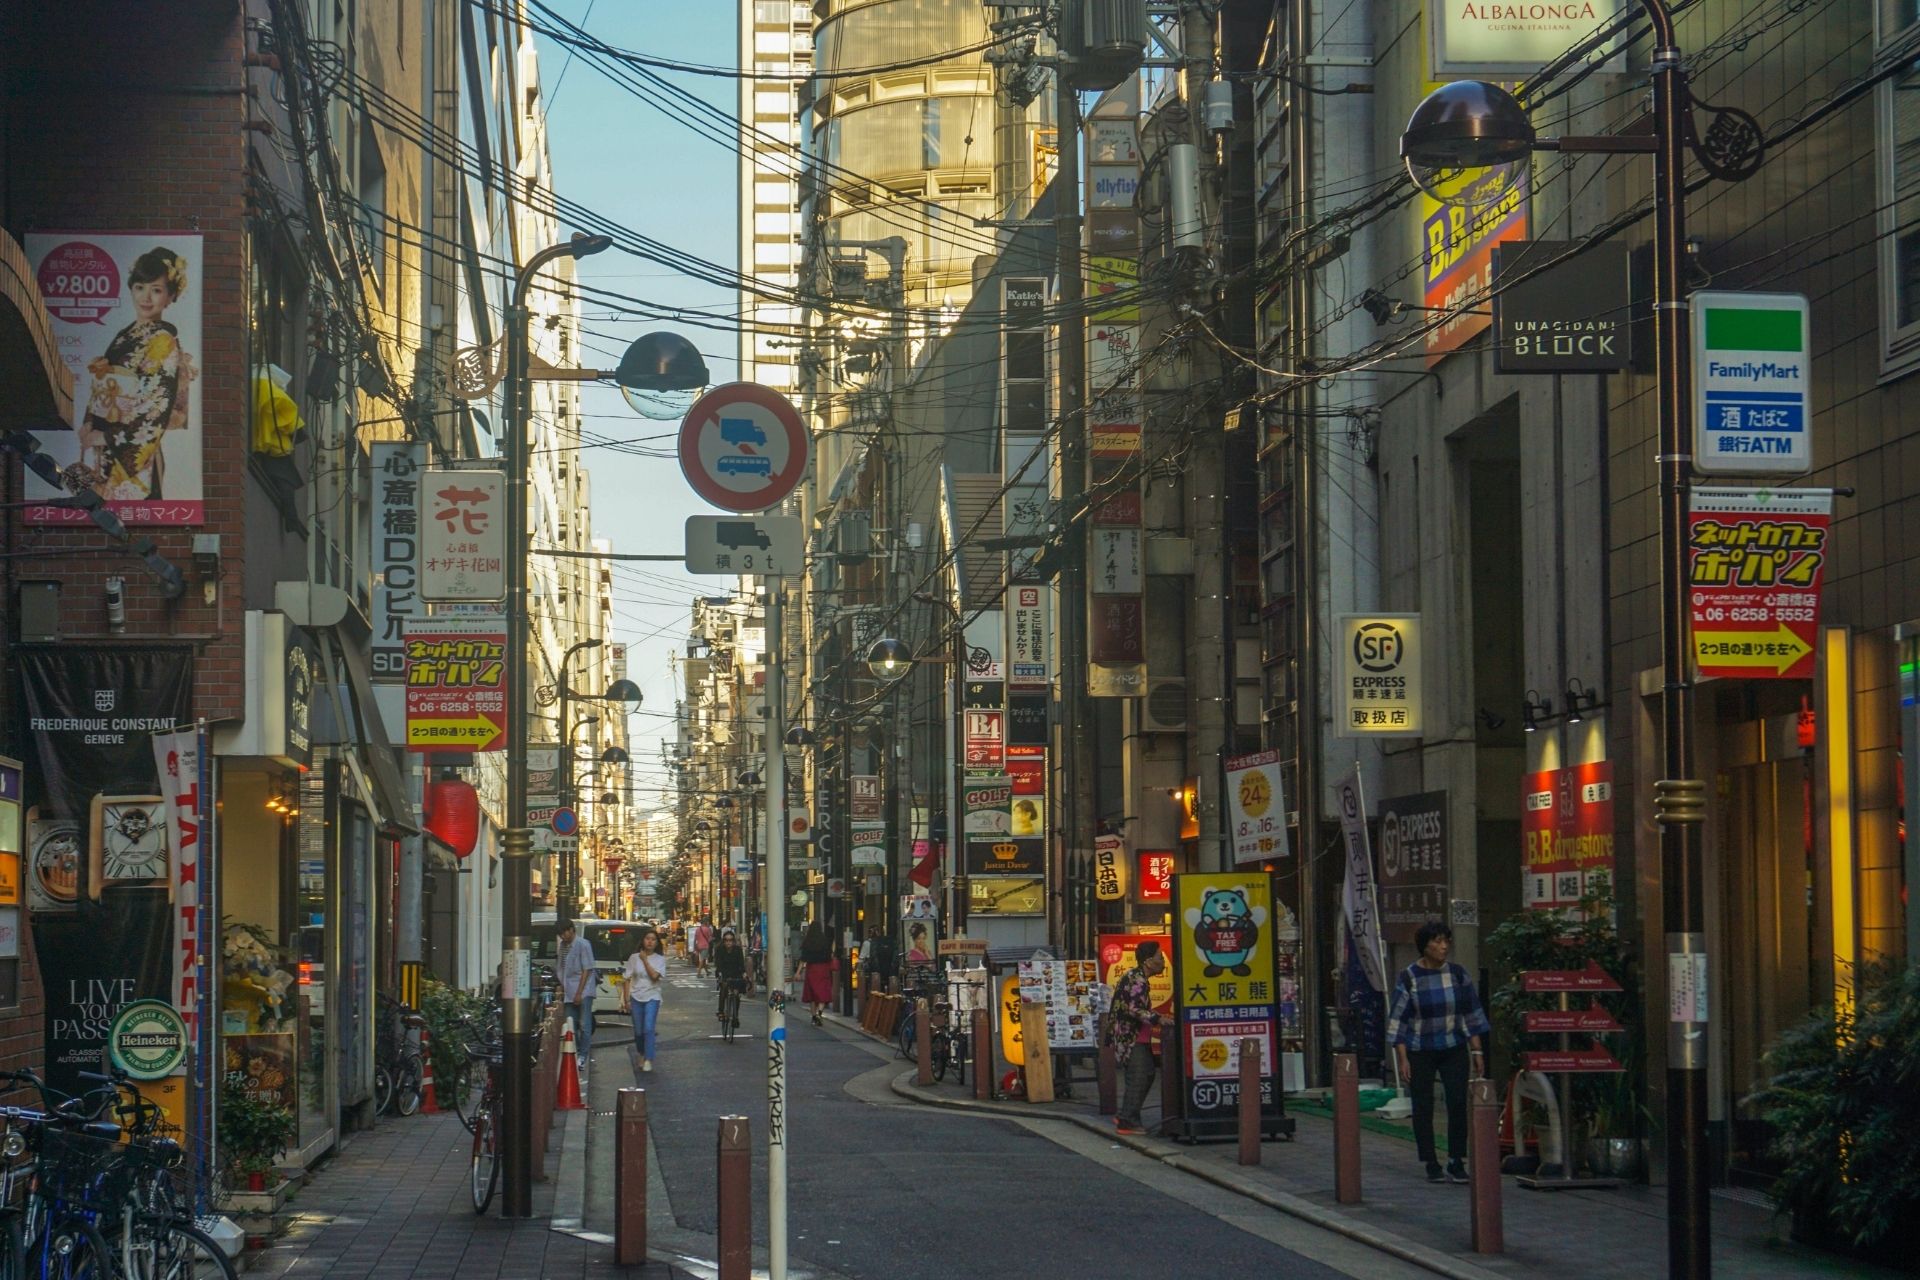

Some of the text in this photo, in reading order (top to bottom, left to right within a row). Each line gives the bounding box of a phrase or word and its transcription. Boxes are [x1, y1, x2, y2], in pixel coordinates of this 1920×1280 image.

[1462, 2, 1595, 19] ALBALONGA
[1007, 290, 1043, 300] Katie's
[1515, 335, 1616, 355] BLOCK
[1709, 362, 1799, 382] FamilyMart
[1721, 406, 1789, 428] 酒 たばこ
[1718, 436, 1792, 454] 銀行ATM
[33, 507, 57, 520] 2F
[435, 485, 490, 535] 花
[1694, 522, 1822, 547] ネットカフェ
[382, 451, 417, 640] 心斎橋DCビル
[446, 543, 478, 553] 心斎橋
[426, 558, 500, 573] オザキ花園
[715, 554, 774, 569] 積 3 t
[1693, 549, 1820, 582] ポパイ
[1021, 590, 1037, 604] 空
[1763, 593, 1817, 607] 心斎橋店
[408, 641, 503, 658] ネットカフェ
[1363, 636, 1394, 660] SF
[1700, 643, 1801, 656] 2つ目の通りを左へ
[408, 660, 503, 684] ポパイ
[1353, 677, 1406, 688] EXPRESS
[465, 692, 503, 702] 心斎橋店
[30, 717, 176, 731] FREDERIQUE CONSTANT
[1354, 710, 1405, 724] 取扱店
[85, 735, 124, 744] GENEVE
[968, 789, 1009, 804] GOLF
[1241, 785, 1262, 807] 24
[529, 807, 555, 820] OLF
[1401, 811, 1441, 841] EXPRESS
[552, 840, 577, 848] 自動車
[853, 831, 883, 842] GOLF
[1098, 851, 1119, 895] 日本酒
[1160, 857, 1170, 889] ワインの
[1216, 939, 1237, 947] FREE
[70, 978, 137, 1005] LIVE
[1189, 982, 1268, 1001] 大阪熊
[1190, 1008, 1269, 1019] 薬・化粧品・日用品
[121, 1035, 177, 1046] Heineken
[58, 1056, 100, 1064] AUTOMATIC
[1200, 1049, 1219, 1062] 24
[163, 1085, 176, 1094] 3F
